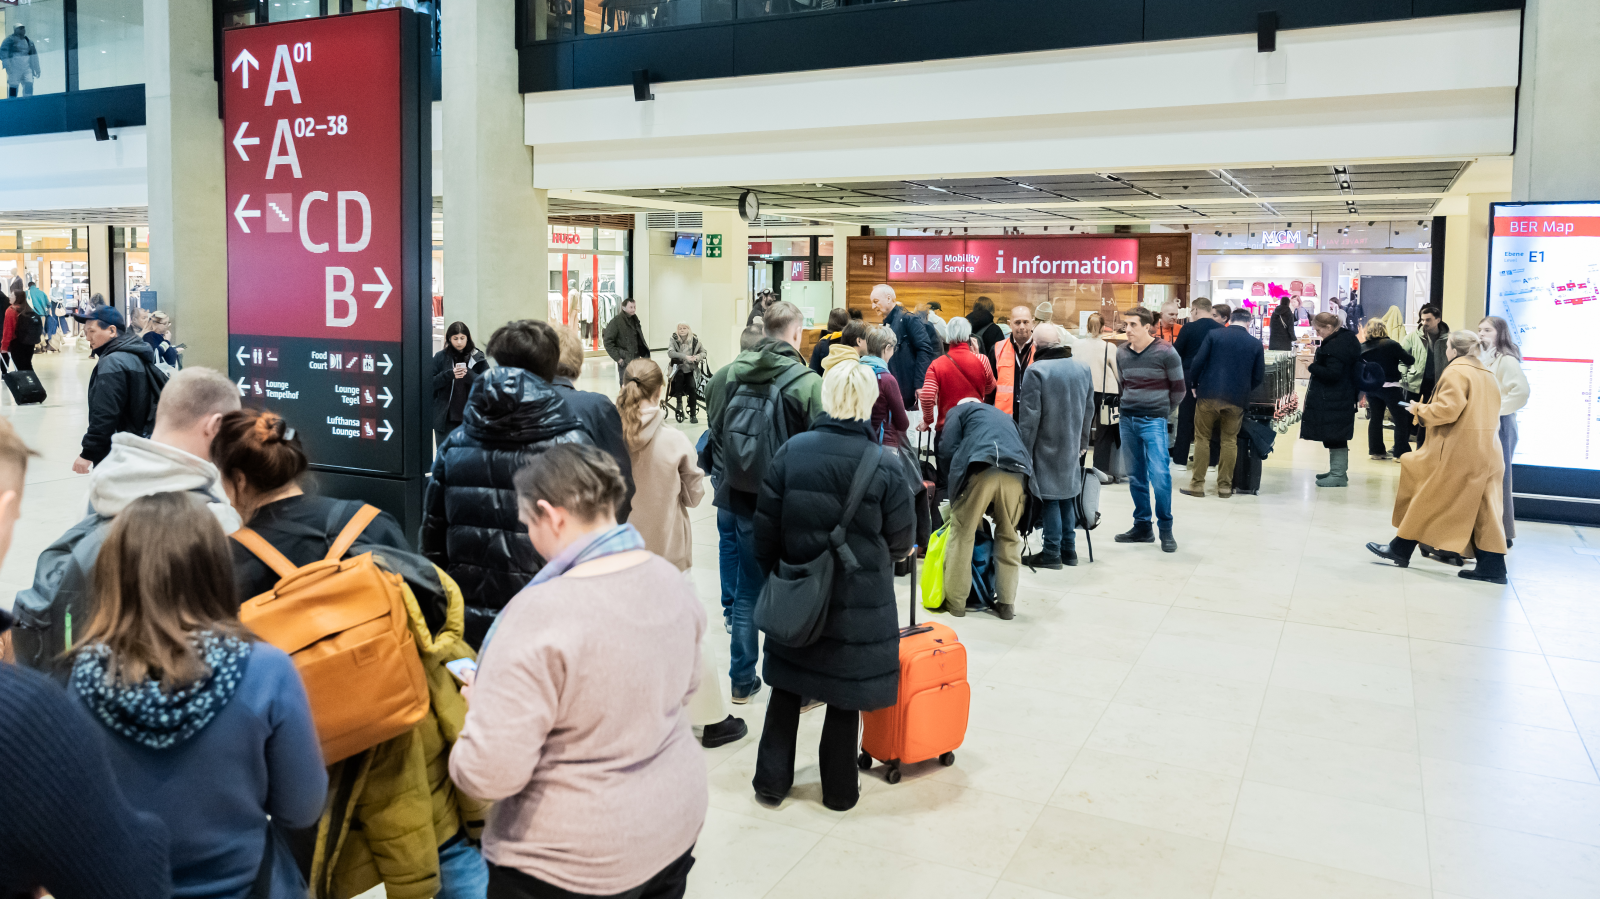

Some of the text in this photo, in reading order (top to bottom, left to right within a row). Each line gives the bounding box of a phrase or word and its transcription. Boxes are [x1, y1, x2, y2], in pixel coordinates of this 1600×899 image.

[299, 190, 372, 253] CD
[1510, 221, 1574, 235] BER Map
[552, 232, 580, 245] HUGO
[1261, 230, 1302, 244] MCM
[944, 253, 980, 265] Mobility
[1528, 250, 1545, 263] E1
[944, 264, 975, 273] Service
[1012, 255, 1134, 275] Information
[325, 266, 358, 328] B
[311, 351, 328, 360] Food
[309, 361, 328, 370] Court
[265, 379, 289, 391] Lounge
[334, 384, 360, 396] Lounge
[265, 389, 300, 400] Tempelhof
[341, 395, 360, 406] Tegel
[326, 415, 360, 427] Lufthansa
[331, 426, 360, 438] Lounges
